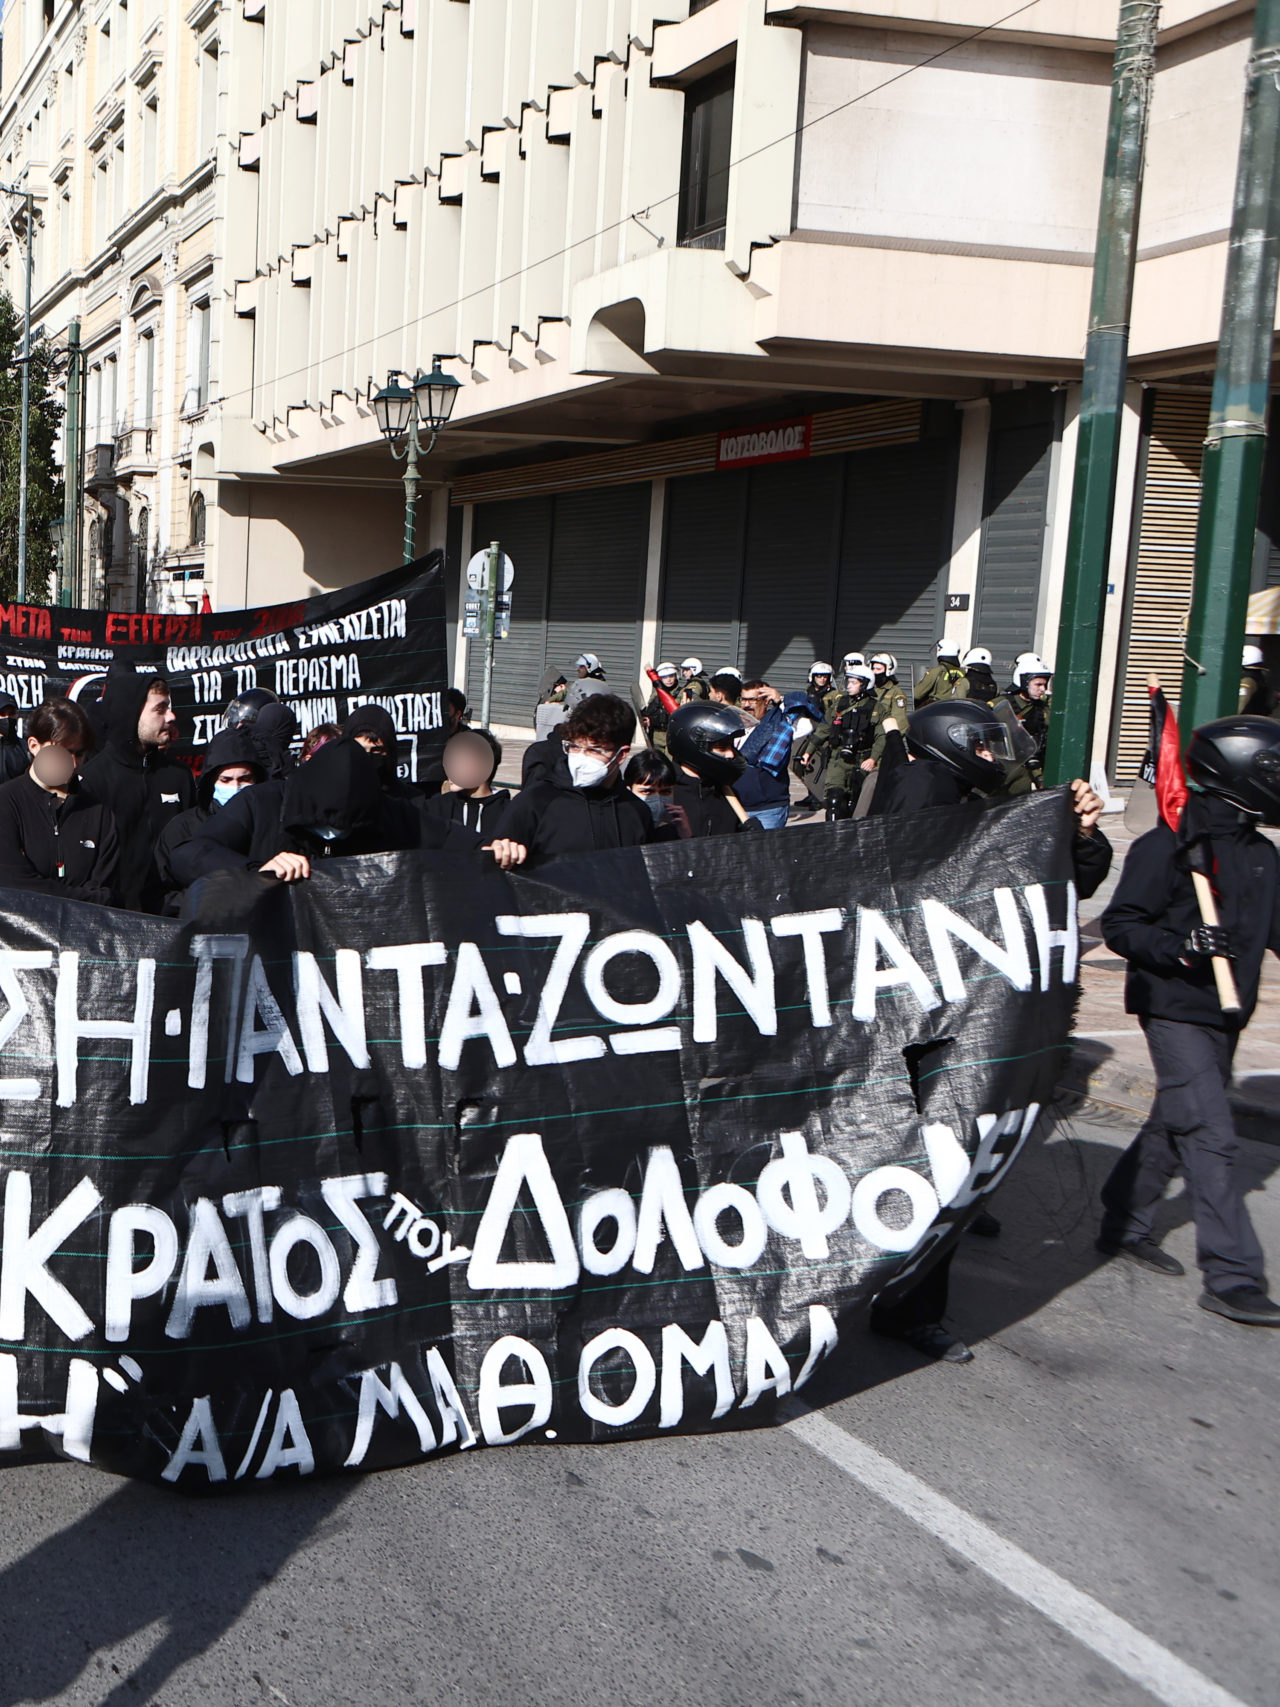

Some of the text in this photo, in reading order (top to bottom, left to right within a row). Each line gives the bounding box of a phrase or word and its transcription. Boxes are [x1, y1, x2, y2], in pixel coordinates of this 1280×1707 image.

[950, 596, 960, 607] 34
[60, 627, 92, 643] ΤΗΝ
[166, 599, 407, 673] ΒΑΡΒΑΡΟΤΗΤΑ ΣΥΝΕΧΙΖΕΤΑΙ
[57, 645, 114, 660] ΚΡΑΤΙΚΗ
[191, 653, 361, 704] ΓΙΑ ΤΟ ΠΕΡΑΣΜΑ
[495, 879, 1078, 1066] ΖΩΝΤΑΝΗ
